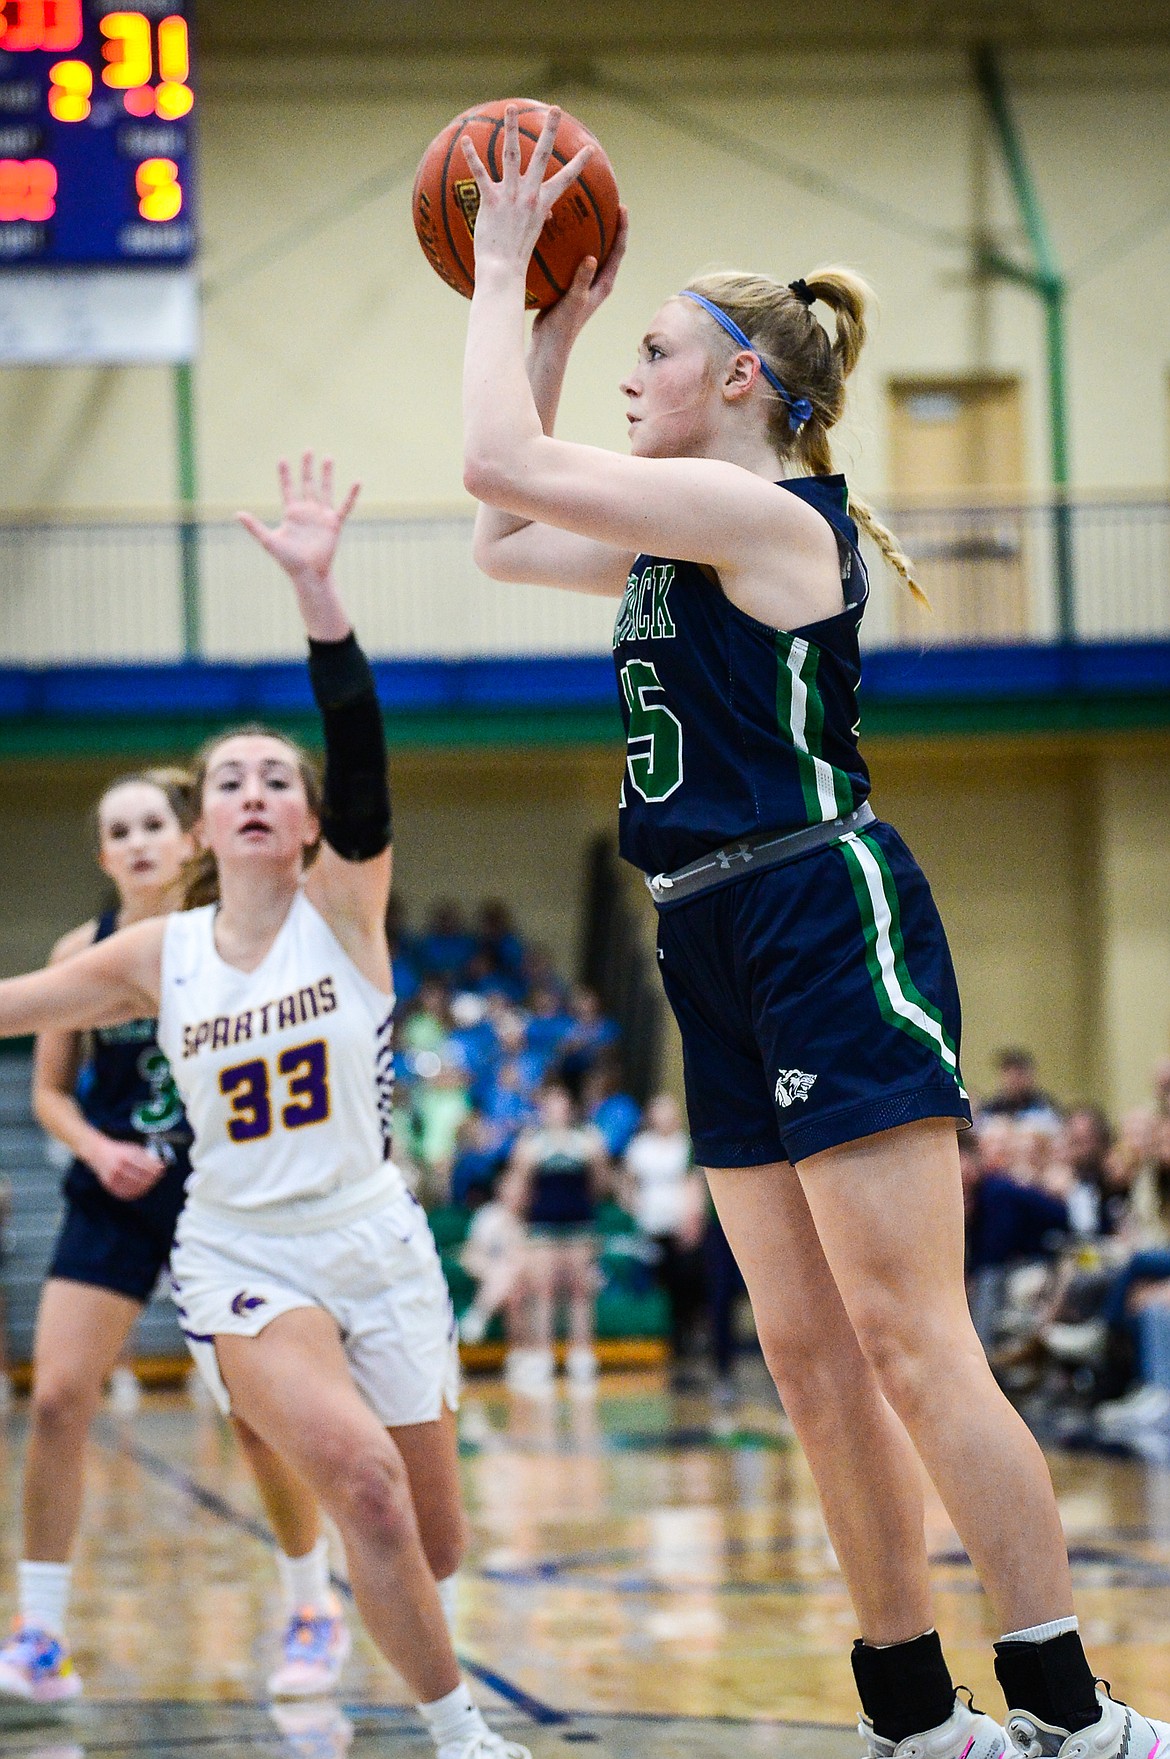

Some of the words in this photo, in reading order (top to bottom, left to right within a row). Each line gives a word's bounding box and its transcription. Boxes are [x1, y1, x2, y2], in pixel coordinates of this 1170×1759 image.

[100, 12, 190, 89] 31
[182, 975, 337, 1060] SPARTANS
[218, 1037, 332, 1145] 33
